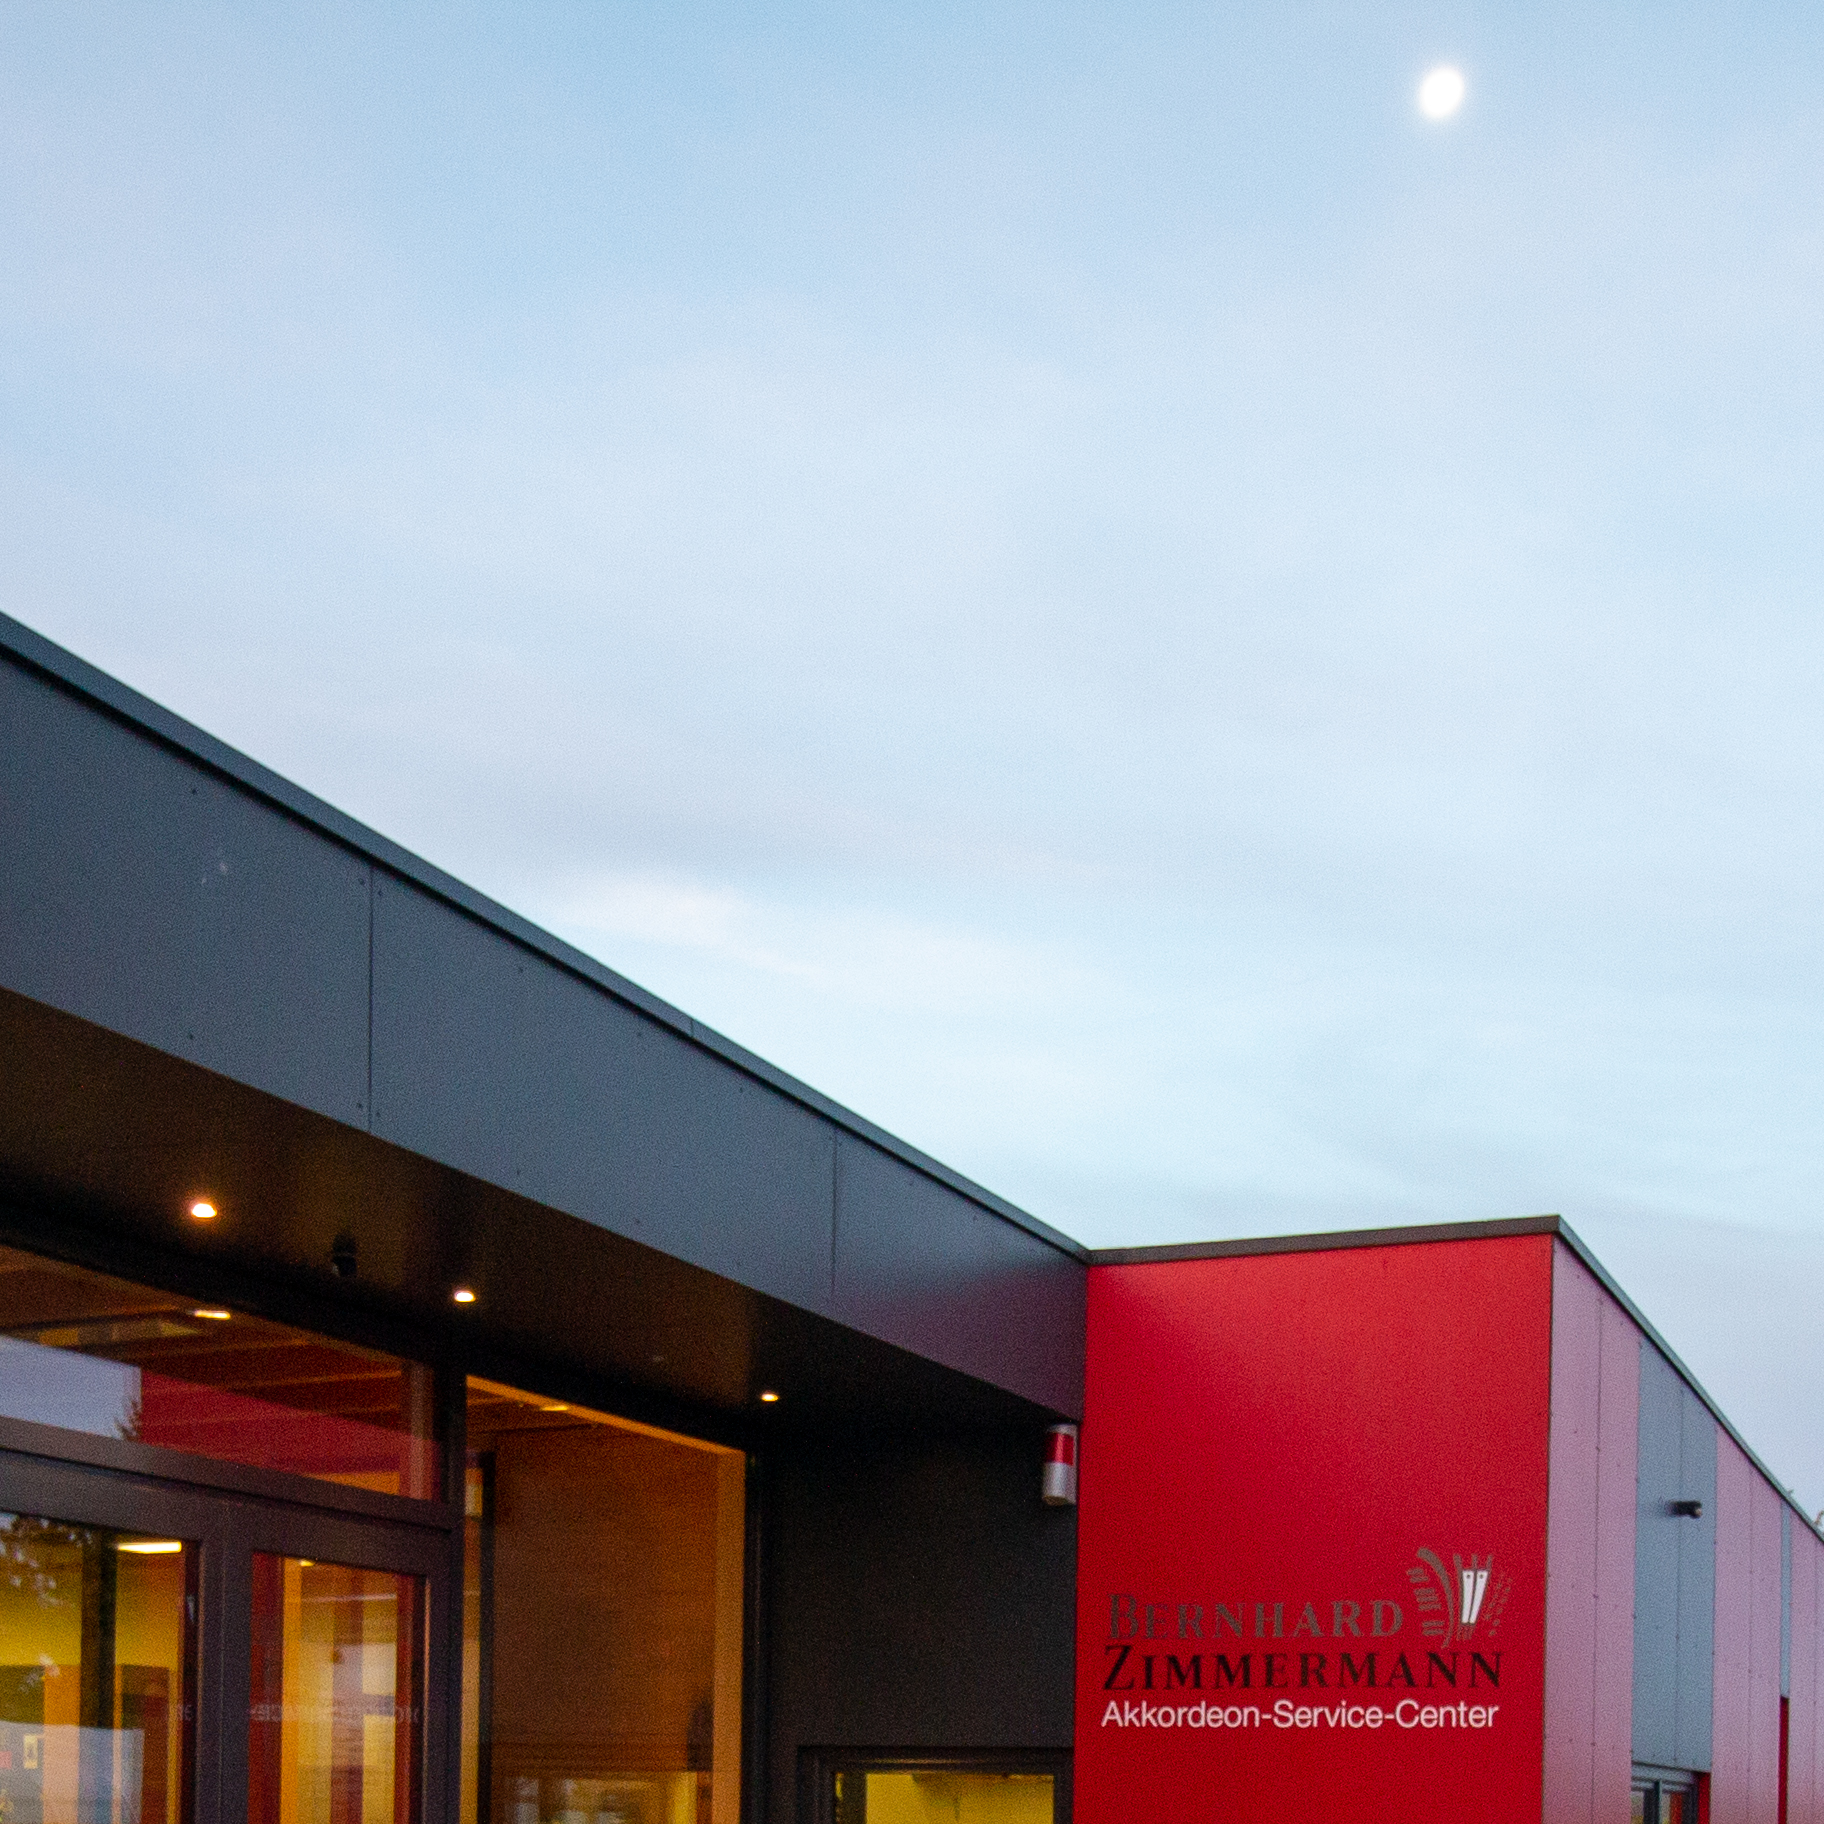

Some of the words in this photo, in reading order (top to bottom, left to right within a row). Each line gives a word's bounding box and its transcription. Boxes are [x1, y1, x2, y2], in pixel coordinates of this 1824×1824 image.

[1109, 1593, 1404, 1638] BERNHARD
[1103, 1644, 1503, 1690] ZIMMERMANN
[1101, 1698, 1500, 1728] Akkordeon-Service-Center
